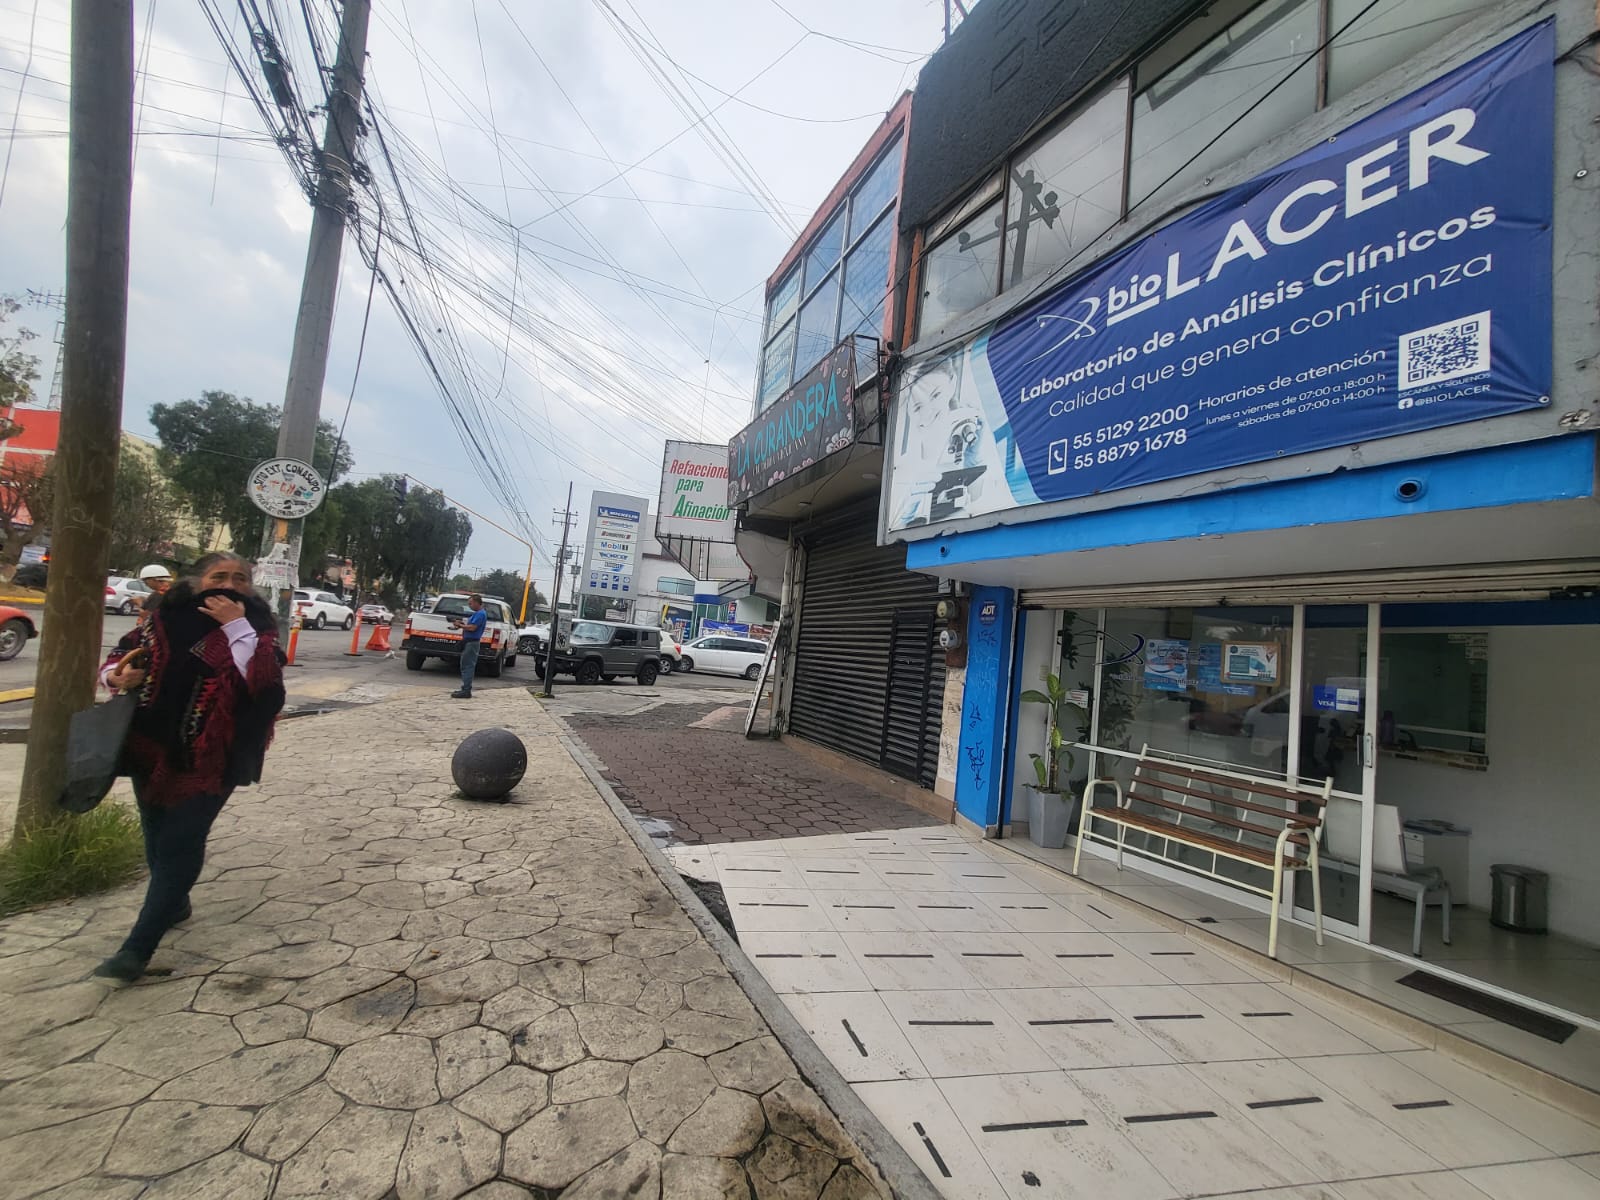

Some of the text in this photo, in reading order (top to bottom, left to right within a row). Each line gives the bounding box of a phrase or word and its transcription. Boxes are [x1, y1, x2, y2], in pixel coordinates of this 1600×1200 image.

[1021, 205, 1497, 403] Laboratorio de Análisis Clínicos
[1049, 253, 1493, 417] Calidad que genera confianza
[1198, 349, 1386, 410] Horarios de atención
[1206, 413, 1231, 425] lunes
[1241, 401, 1280, 415] viernes
[1282, 395, 1297, 405] de
[1299, 386, 1331, 401] 07:00
[1333, 385, 1341, 393] a
[1343, 374, 1375, 390] 18:00
[1377, 373, 1386, 381] h
[1414, 384, 1491, 407] @BIOLACER
[736, 441, 750, 477] LA
[754, 372, 839, 465] CURANDERA
[1073, 404, 1189, 449] 55 5129 2200
[1238, 412, 1281, 428] sábados
[1282, 407, 1297, 417] de
[1298, 398, 1330, 413] 07:00
[1343, 387, 1375, 402] 14:00
[1377, 385, 1386, 394] h
[1074, 429, 1187, 469] 55 8879 1678
[285, 463, 320, 493] CONASUPO
[675, 477, 704, 494] para
[673, 495, 730, 521] Afinación
[600, 541, 621, 551] Mobil
[981, 605, 996, 616] ADT
[1318, 699, 1335, 707] VISA
